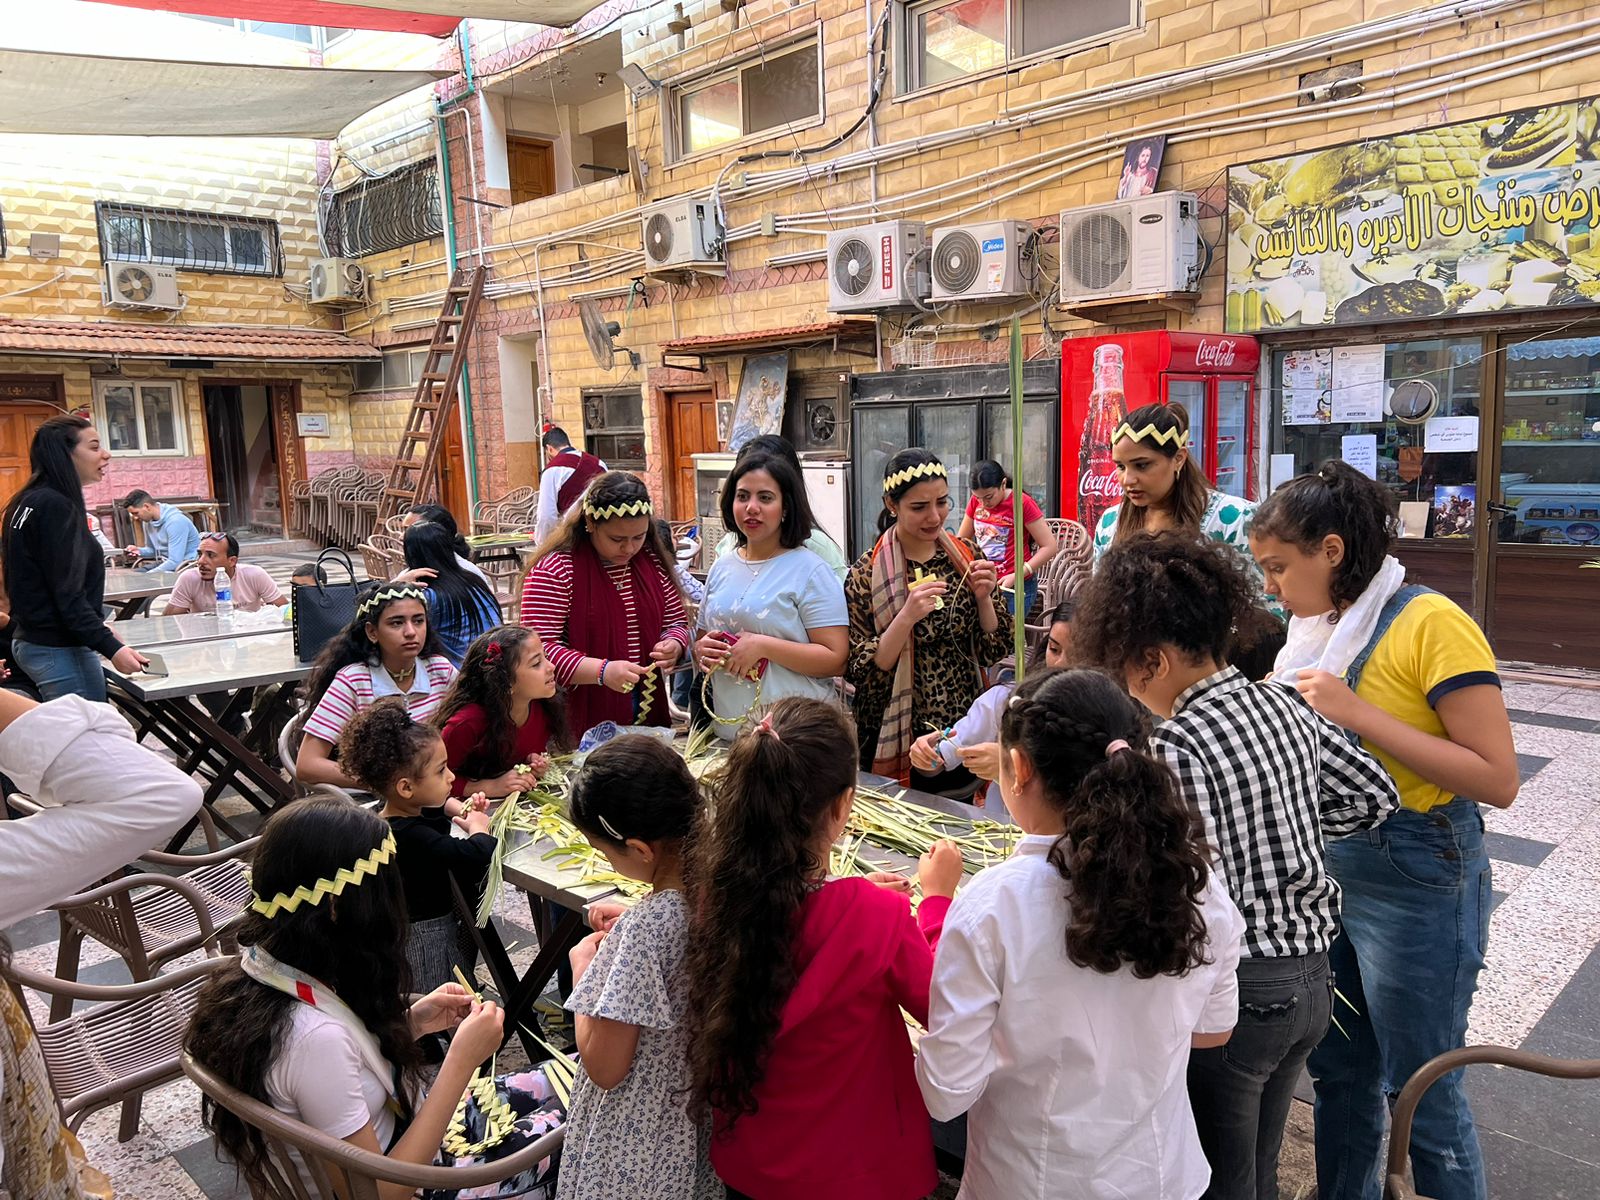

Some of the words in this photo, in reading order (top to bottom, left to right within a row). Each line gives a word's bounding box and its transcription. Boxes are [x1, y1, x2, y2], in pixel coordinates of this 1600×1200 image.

[1357, 186, 1433, 255] الأديرة
[1437, 180, 1537, 242] منتجات
[883, 237, 891, 274] FRESH
[984, 240, 1003, 252] Midea
[1255, 207, 1354, 261] والكنائس
[1195, 338, 1236, 367] Coca-Cola
